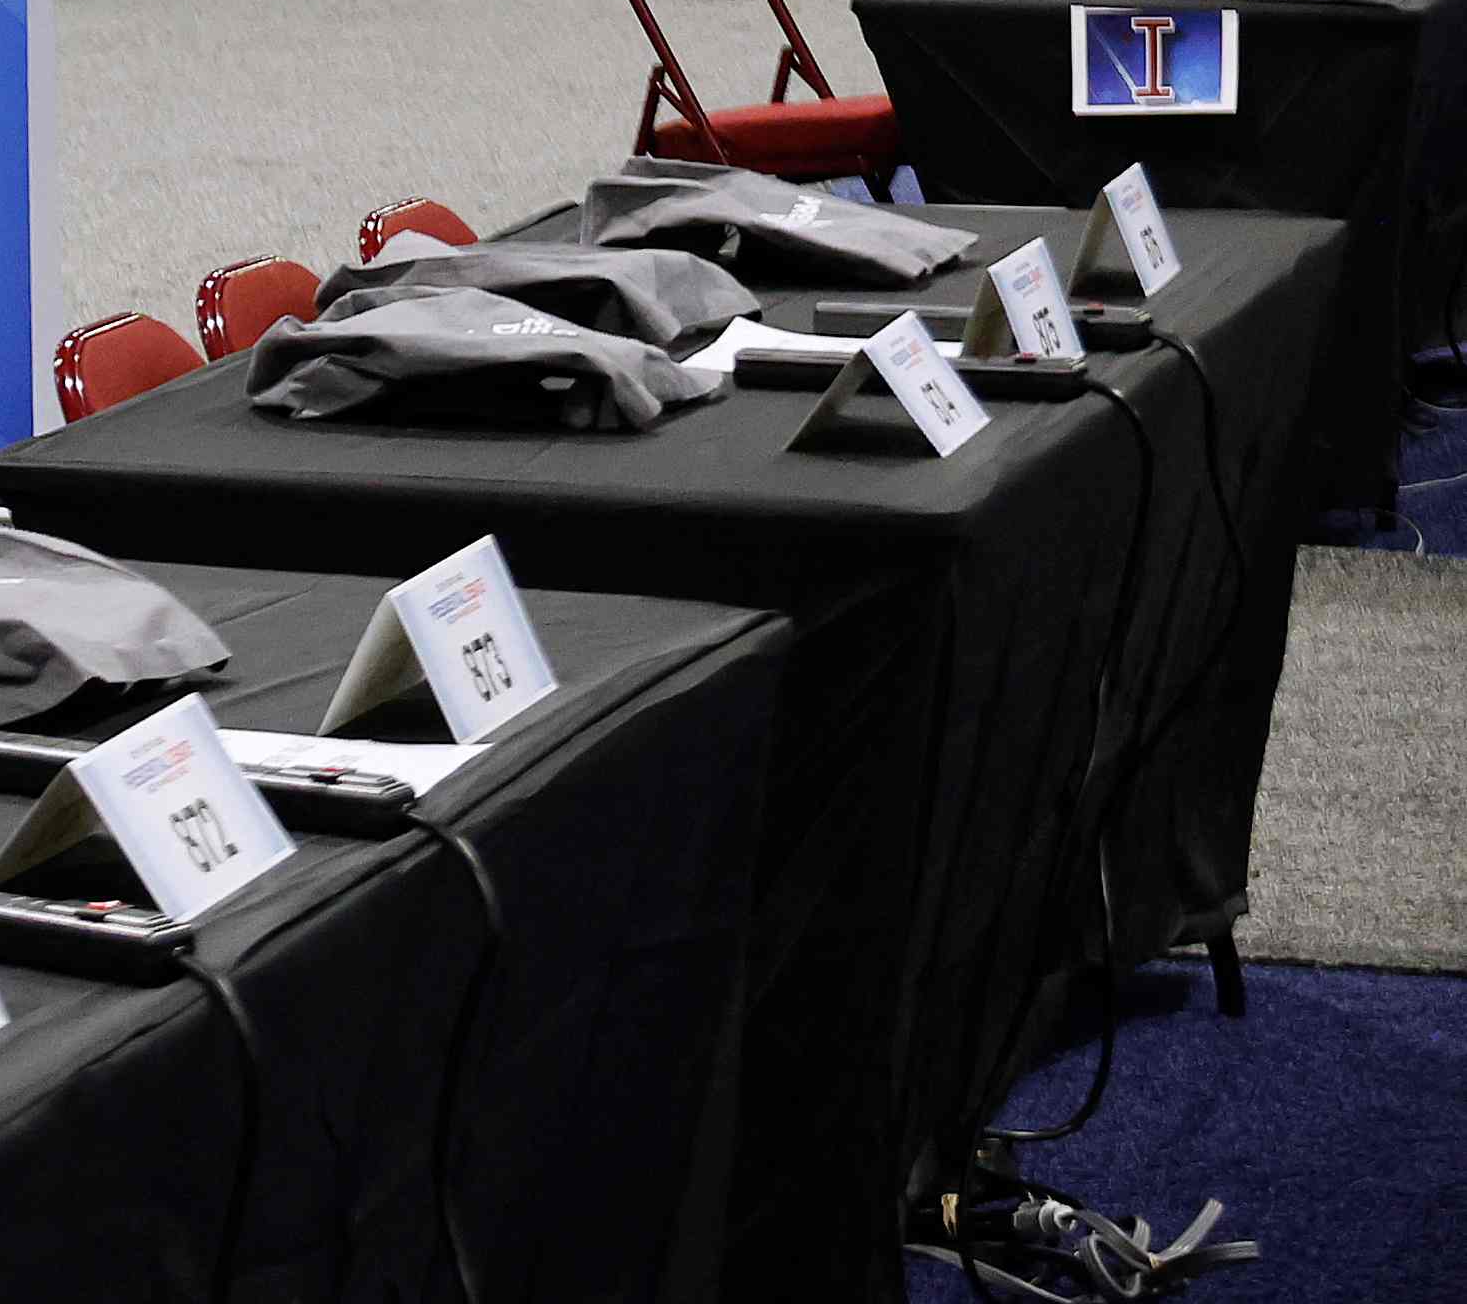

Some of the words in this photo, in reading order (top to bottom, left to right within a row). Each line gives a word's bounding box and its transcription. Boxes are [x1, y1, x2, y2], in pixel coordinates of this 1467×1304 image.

[1131, 15, 1176, 104] I
[462, 632, 513, 703] 873
[168, 797, 239, 873] 872
